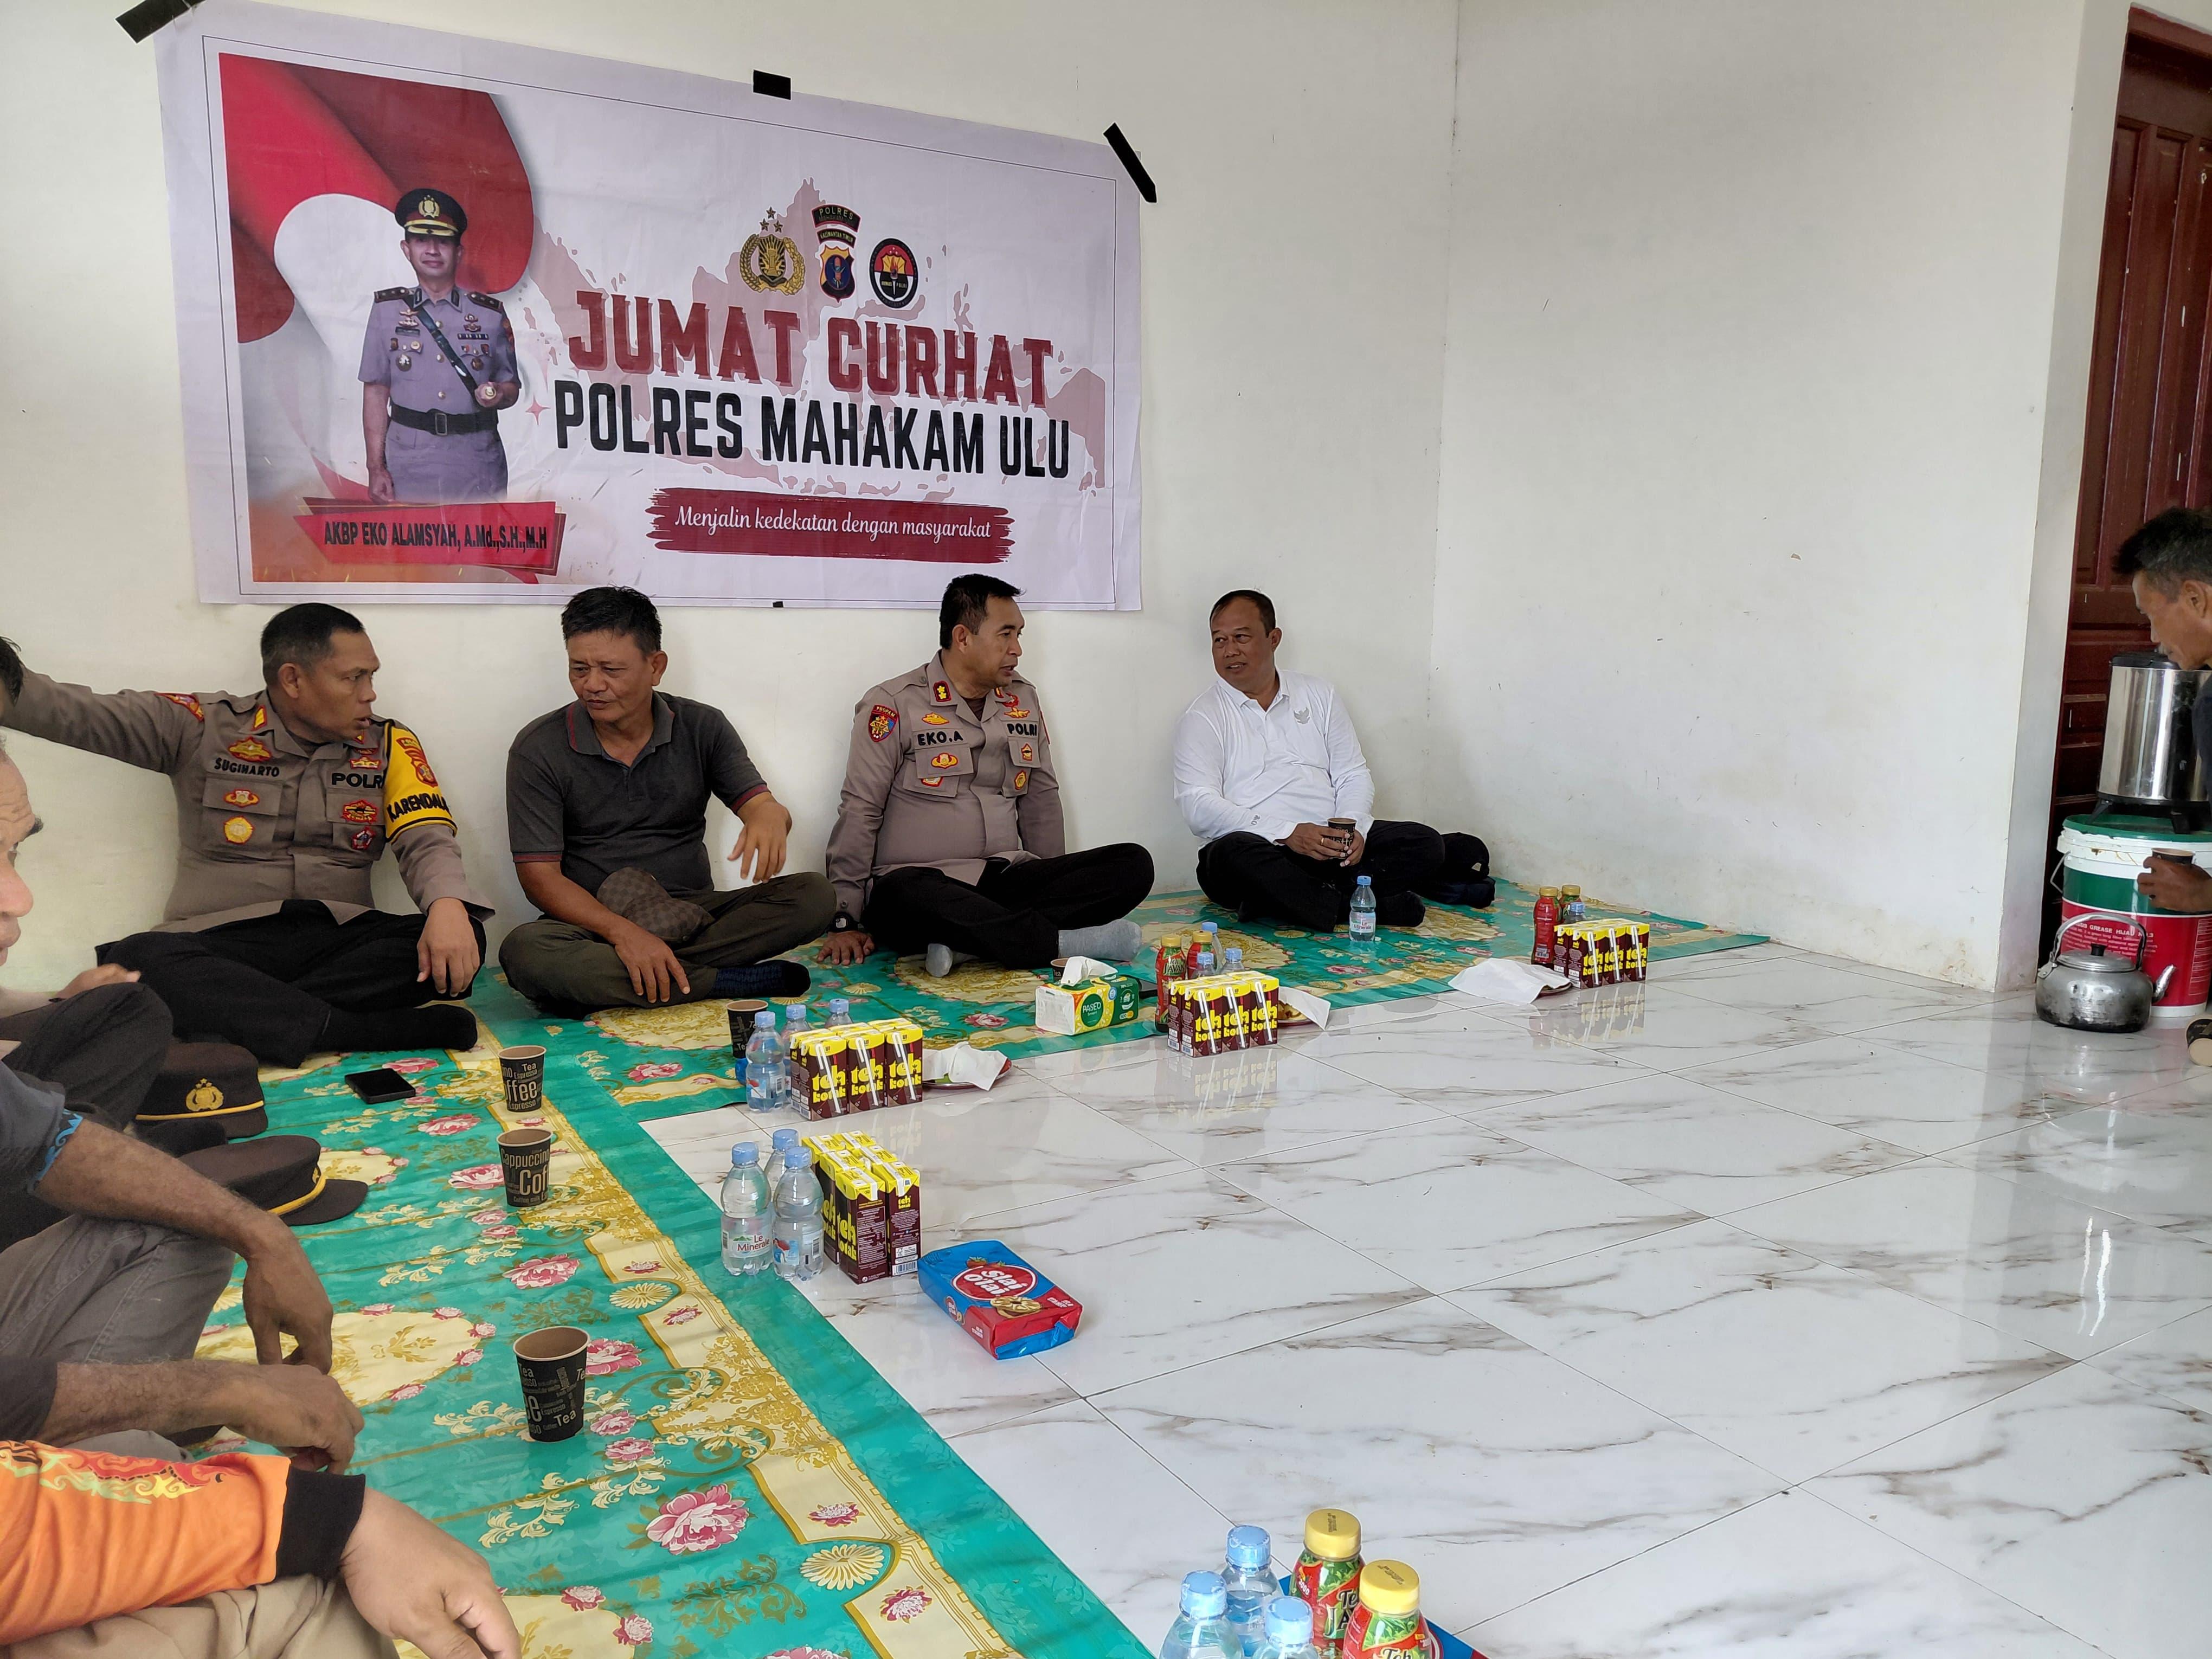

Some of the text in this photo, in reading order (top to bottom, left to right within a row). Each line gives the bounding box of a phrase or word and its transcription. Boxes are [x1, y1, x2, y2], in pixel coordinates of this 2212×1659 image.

[819, 207, 853, 220] POLRES
[569, 291, 1053, 408] JUMAT CURHAT
[555, 380, 1070, 478] POLRES MAHAKAM ULU
[675, 505, 992, 544] Menjalin kedekatan dengan masyarakat
[325, 522, 358, 545] AKBP
[362, 522, 387, 546] EKO
[391, 523, 461, 552] ALAMSYAH,
[876, 706, 896, 717] PROPAM
[1007, 723, 1038, 736] POLRI
[918, 731, 963, 746] EKO.A
[214, 757, 280, 777] SUGIHARTO
[332, 773, 385, 789] POLR
[2089, 925, 2113, 933] GREASE
[1583, 964, 1603, 976] kok
[1604, 961, 1623, 972] kok
[1626, 959, 1646, 969] kok
[1083, 1002, 1102, 1013] PASEO
[522, 1063, 536, 1072] Tea
[505, 1080, 537, 1102] ffee
[520, 1162, 549, 1195] Cof
[837, 1212, 856, 1246] teh
[737, 1238, 770, 1251] Minerale
[754, 1235, 763, 1243] Le
[838, 1236, 857, 1261] otak
[981, 1270, 1028, 1290] Slai
[577, 1368, 585, 1381] Te
[554, 1410, 576, 1427] Tea
